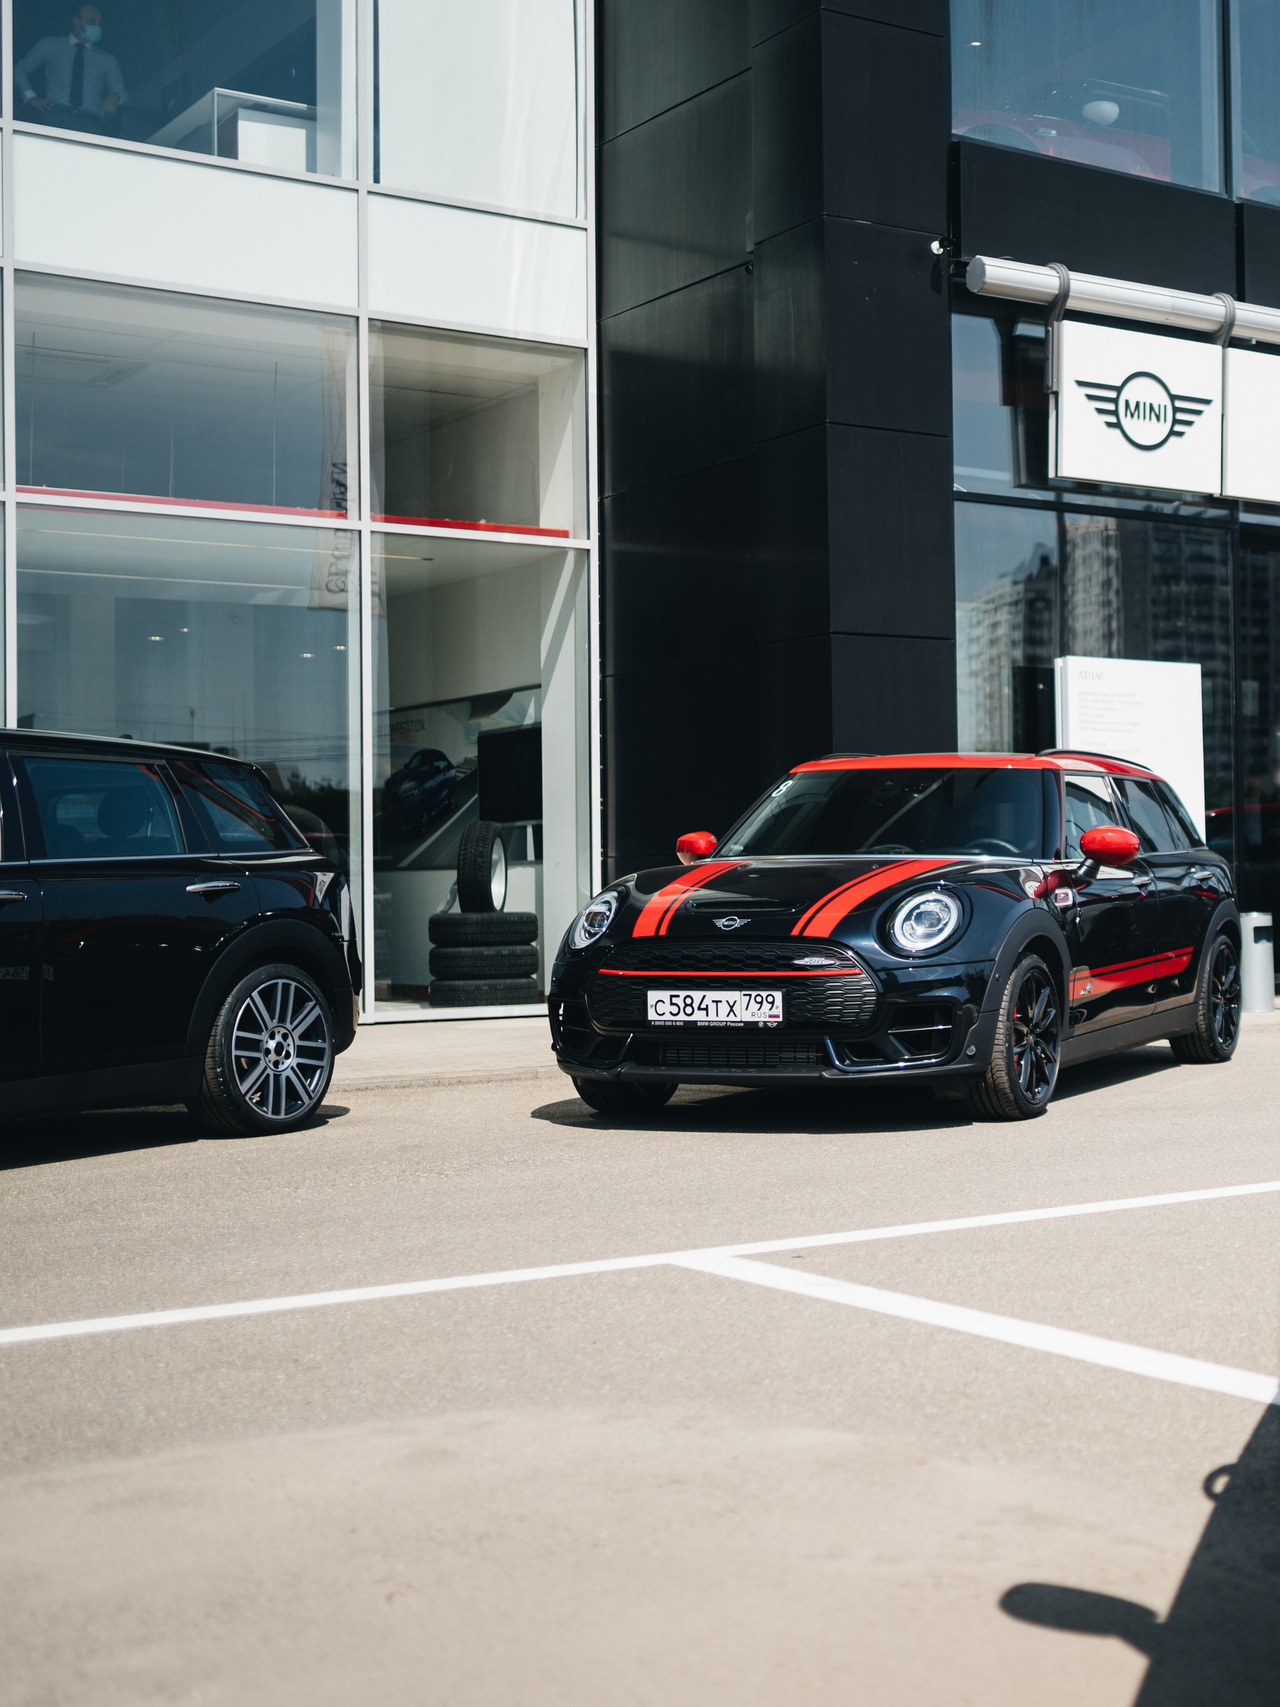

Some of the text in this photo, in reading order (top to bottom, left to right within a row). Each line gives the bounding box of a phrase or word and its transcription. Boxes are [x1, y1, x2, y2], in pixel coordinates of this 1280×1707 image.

[1124, 398, 1168, 424] MINI
[771, 780, 793, 797] 8
[742, 993, 775, 1011] 799
